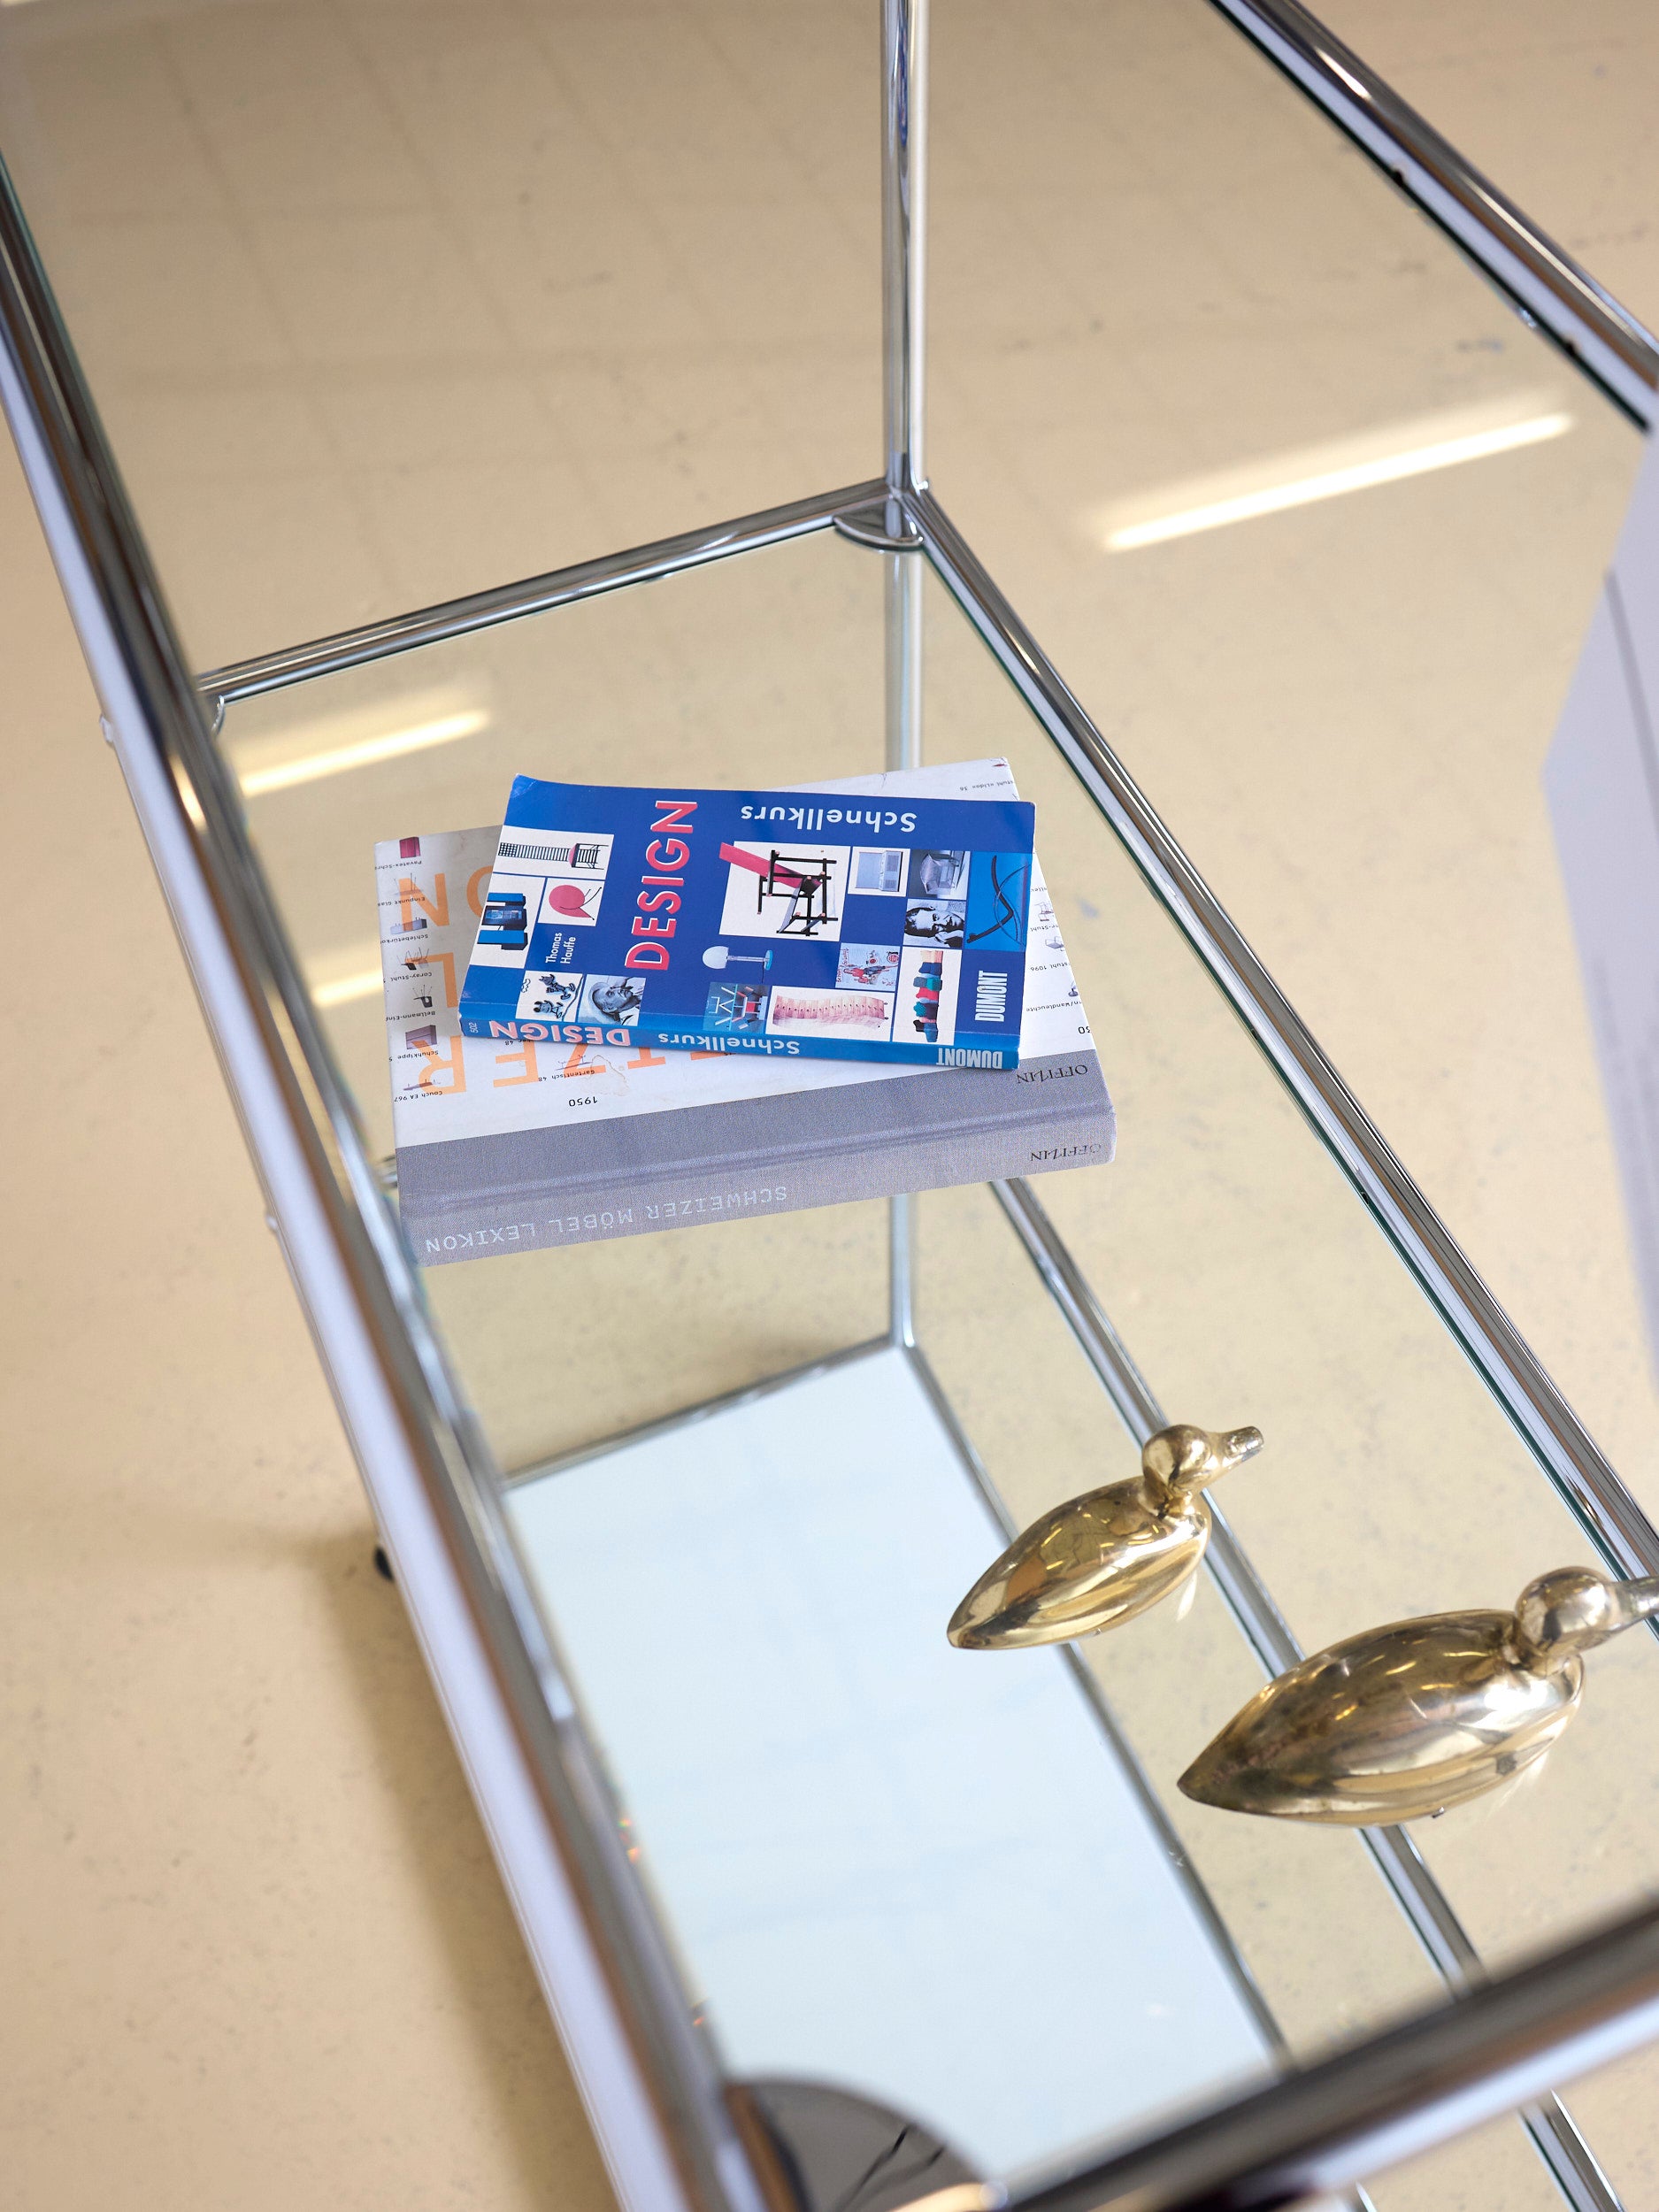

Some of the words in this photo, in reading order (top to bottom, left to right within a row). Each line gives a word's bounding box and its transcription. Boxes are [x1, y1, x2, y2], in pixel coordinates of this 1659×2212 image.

[740, 805, 918, 833] Schnellkurs
[624, 800, 698, 971] DESIGN
[545, 932, 562, 964] Thomas
[560, 936, 576, 964] Hauffe
[974, 970, 1008, 1023] DUMONT
[488, 1019, 632, 1047] DESIGN
[657, 1033, 800, 1055] Schnellkurs
[935, 1048, 1003, 1069] DUMONT
[551, 1069, 595, 1080] Gartentisch
[1016, 1064, 1088, 1084] OFFIZIN
[568, 1095, 598, 1108] 1950
[1030, 1143, 1102, 1161] OFFIZIN
[646, 1186, 787, 1219] SCHWEIZER
[548, 1208, 633, 1233] MÖBEL
[425, 1223, 534, 1253] LEXIKON
